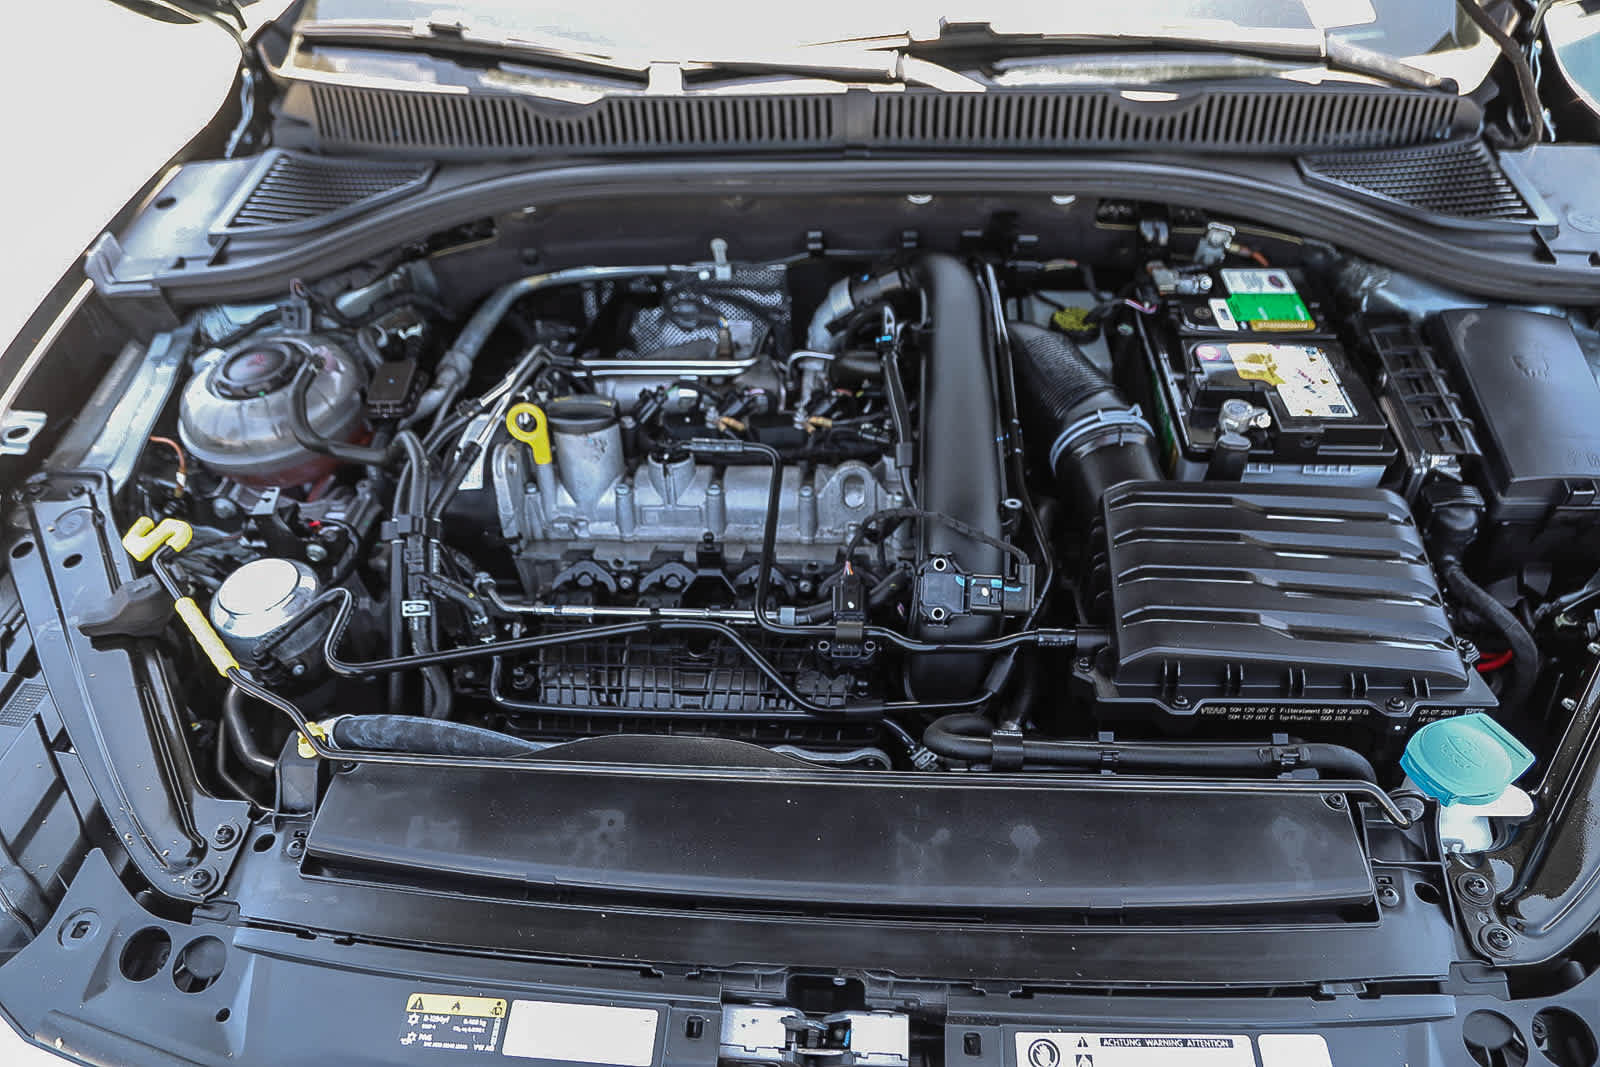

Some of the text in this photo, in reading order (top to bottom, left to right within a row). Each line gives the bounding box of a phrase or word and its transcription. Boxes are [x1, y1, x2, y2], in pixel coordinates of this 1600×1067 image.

[1103, 1038, 1229, 1048] ACHTUNG WARNING ATTENTION
